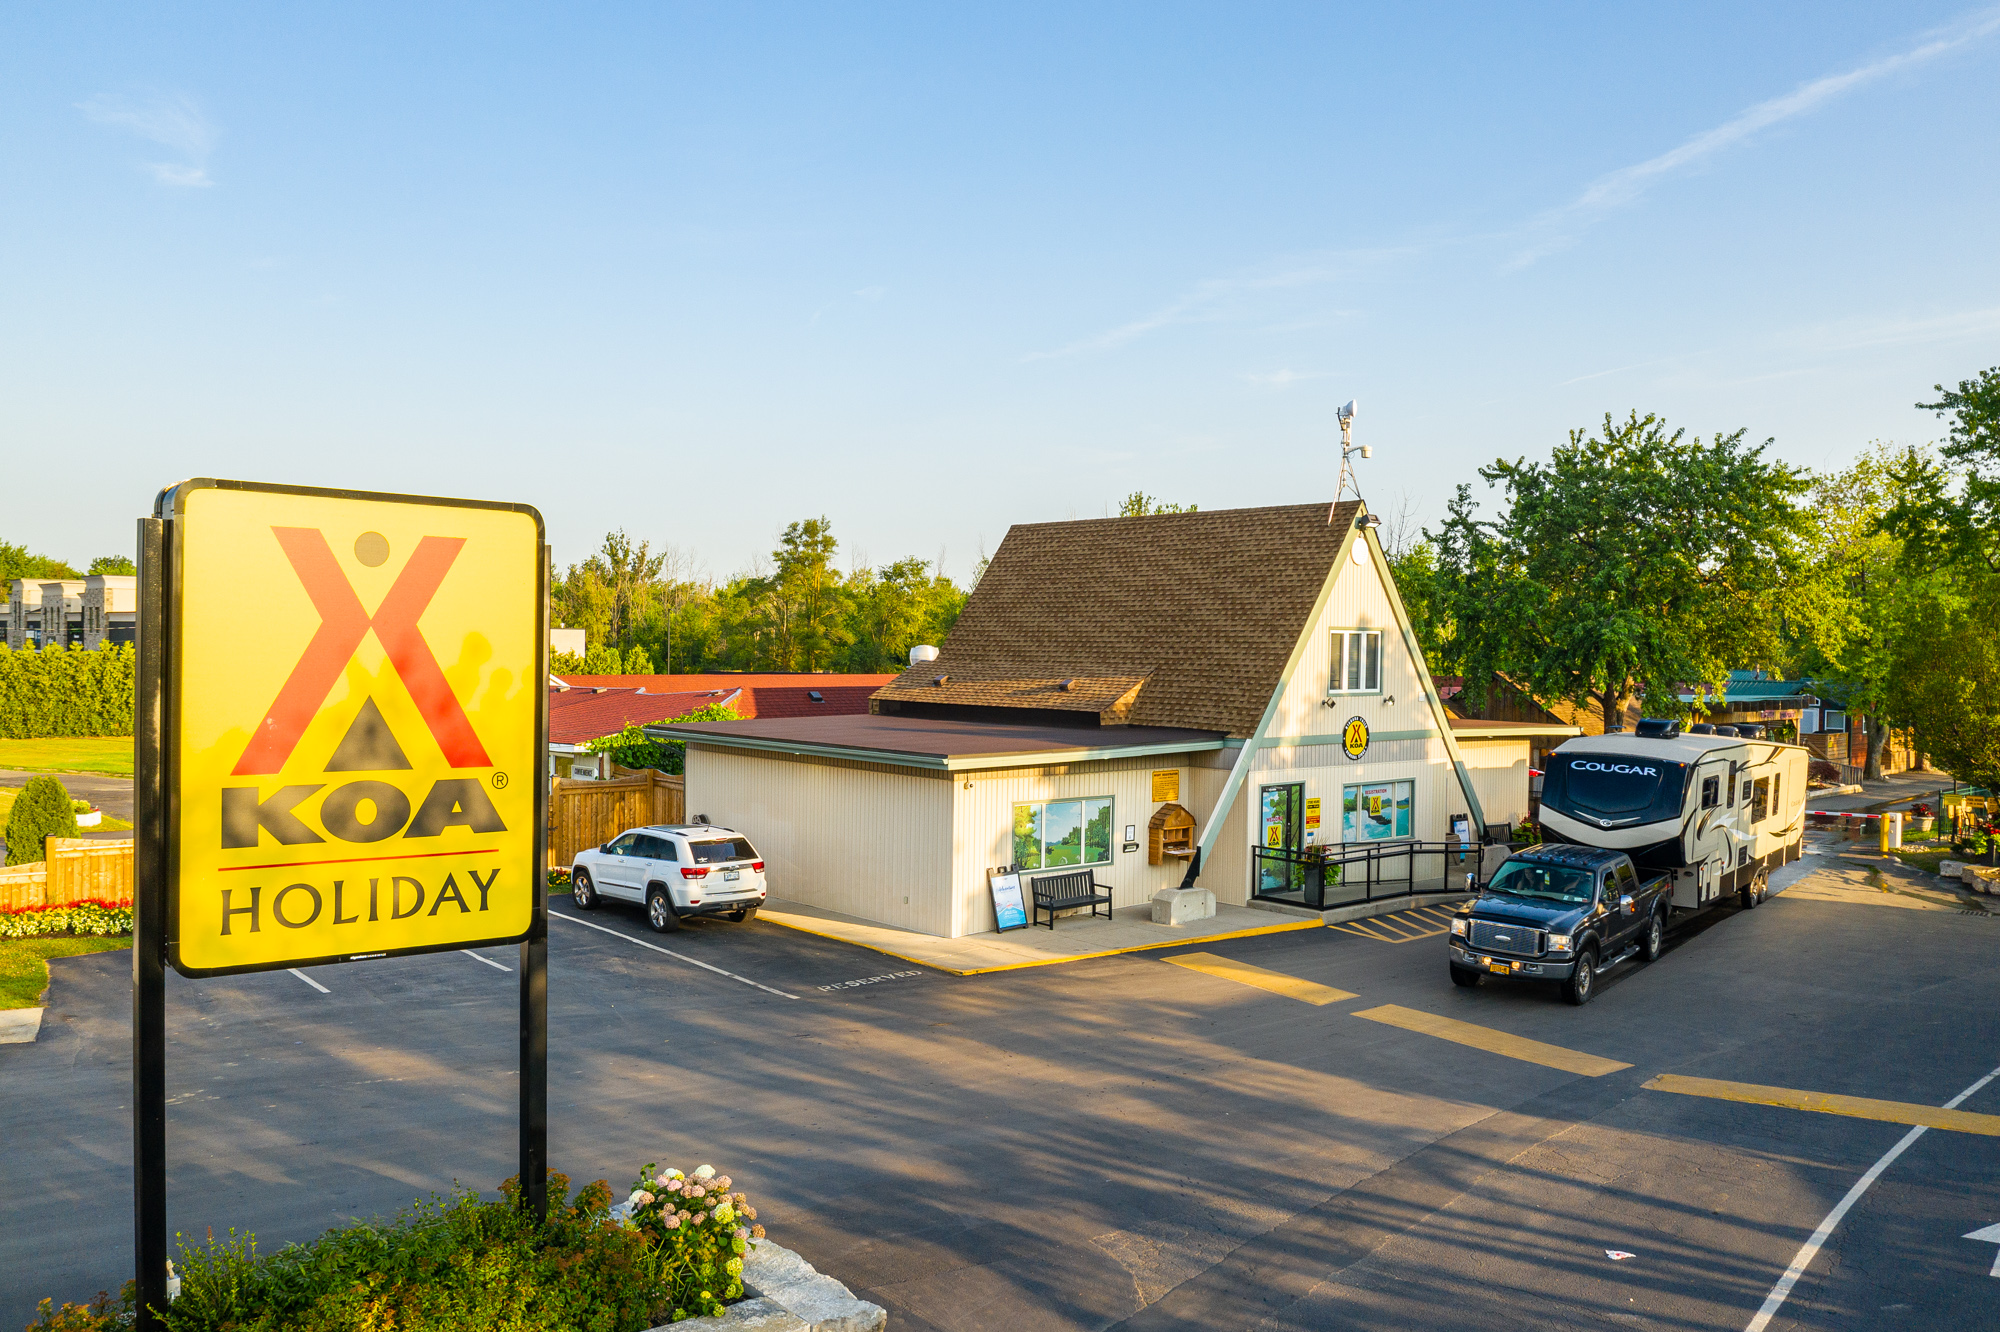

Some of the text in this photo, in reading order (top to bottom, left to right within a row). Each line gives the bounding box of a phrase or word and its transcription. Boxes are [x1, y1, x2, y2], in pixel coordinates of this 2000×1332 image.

[1570, 760, 1658, 777] COUGAR
[221, 778, 508, 849] KOA
[219, 868, 501, 937] HOLIDAY
[816, 970, 923, 992] RESERVED
